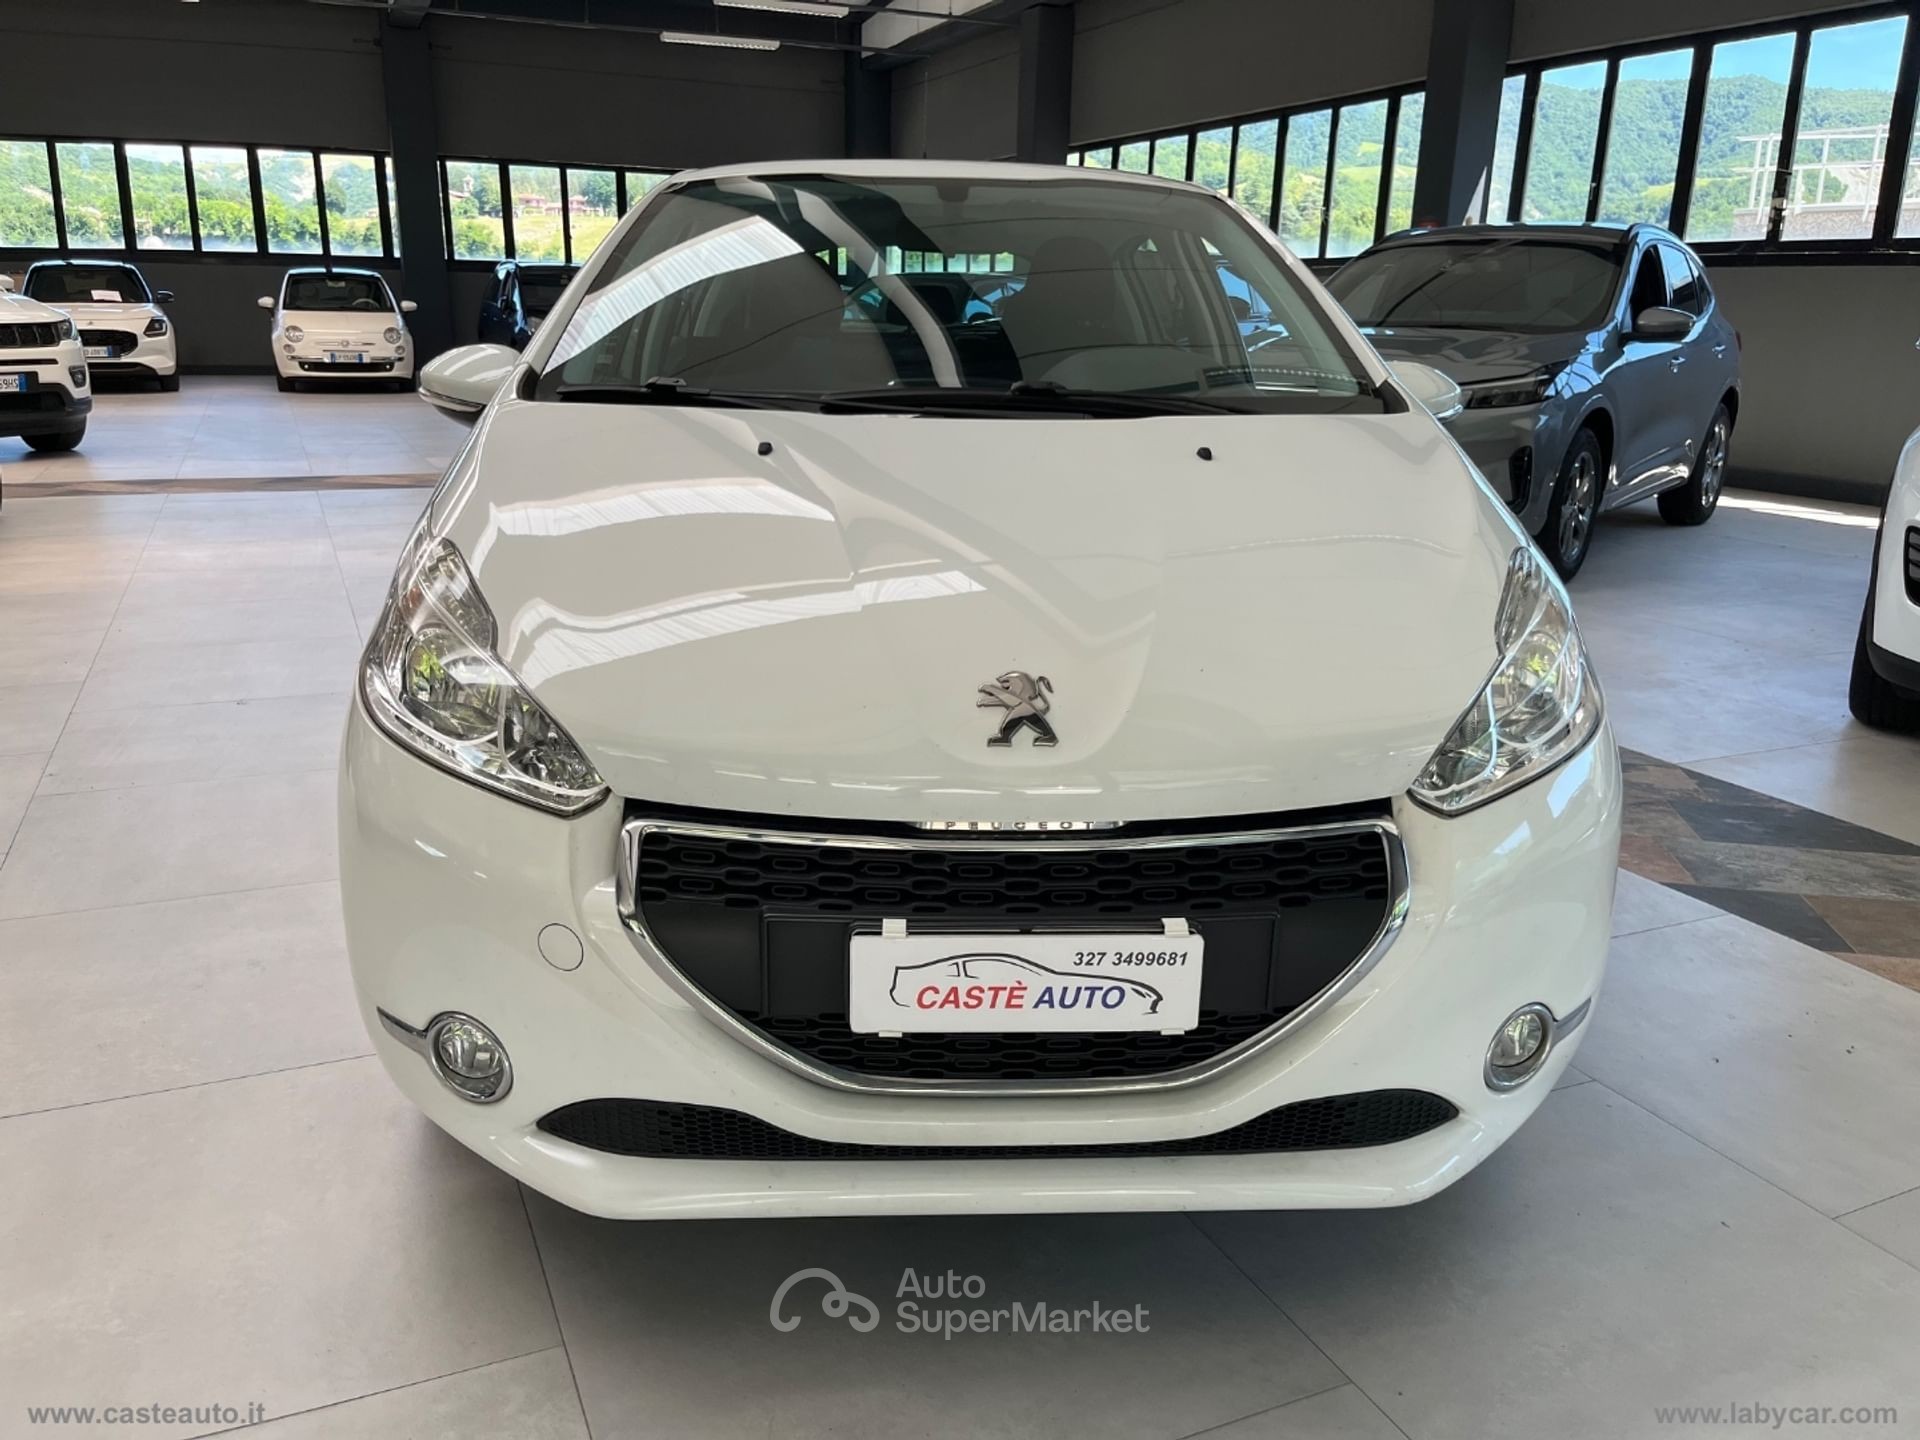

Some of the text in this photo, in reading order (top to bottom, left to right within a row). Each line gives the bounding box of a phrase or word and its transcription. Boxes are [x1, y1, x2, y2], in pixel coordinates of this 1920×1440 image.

[944, 821, 1095, 831] PEUGEOT
[1073, 952, 1188, 966] 327 3499681
[917, 981, 1125, 1009] CASTÈ AUTO
